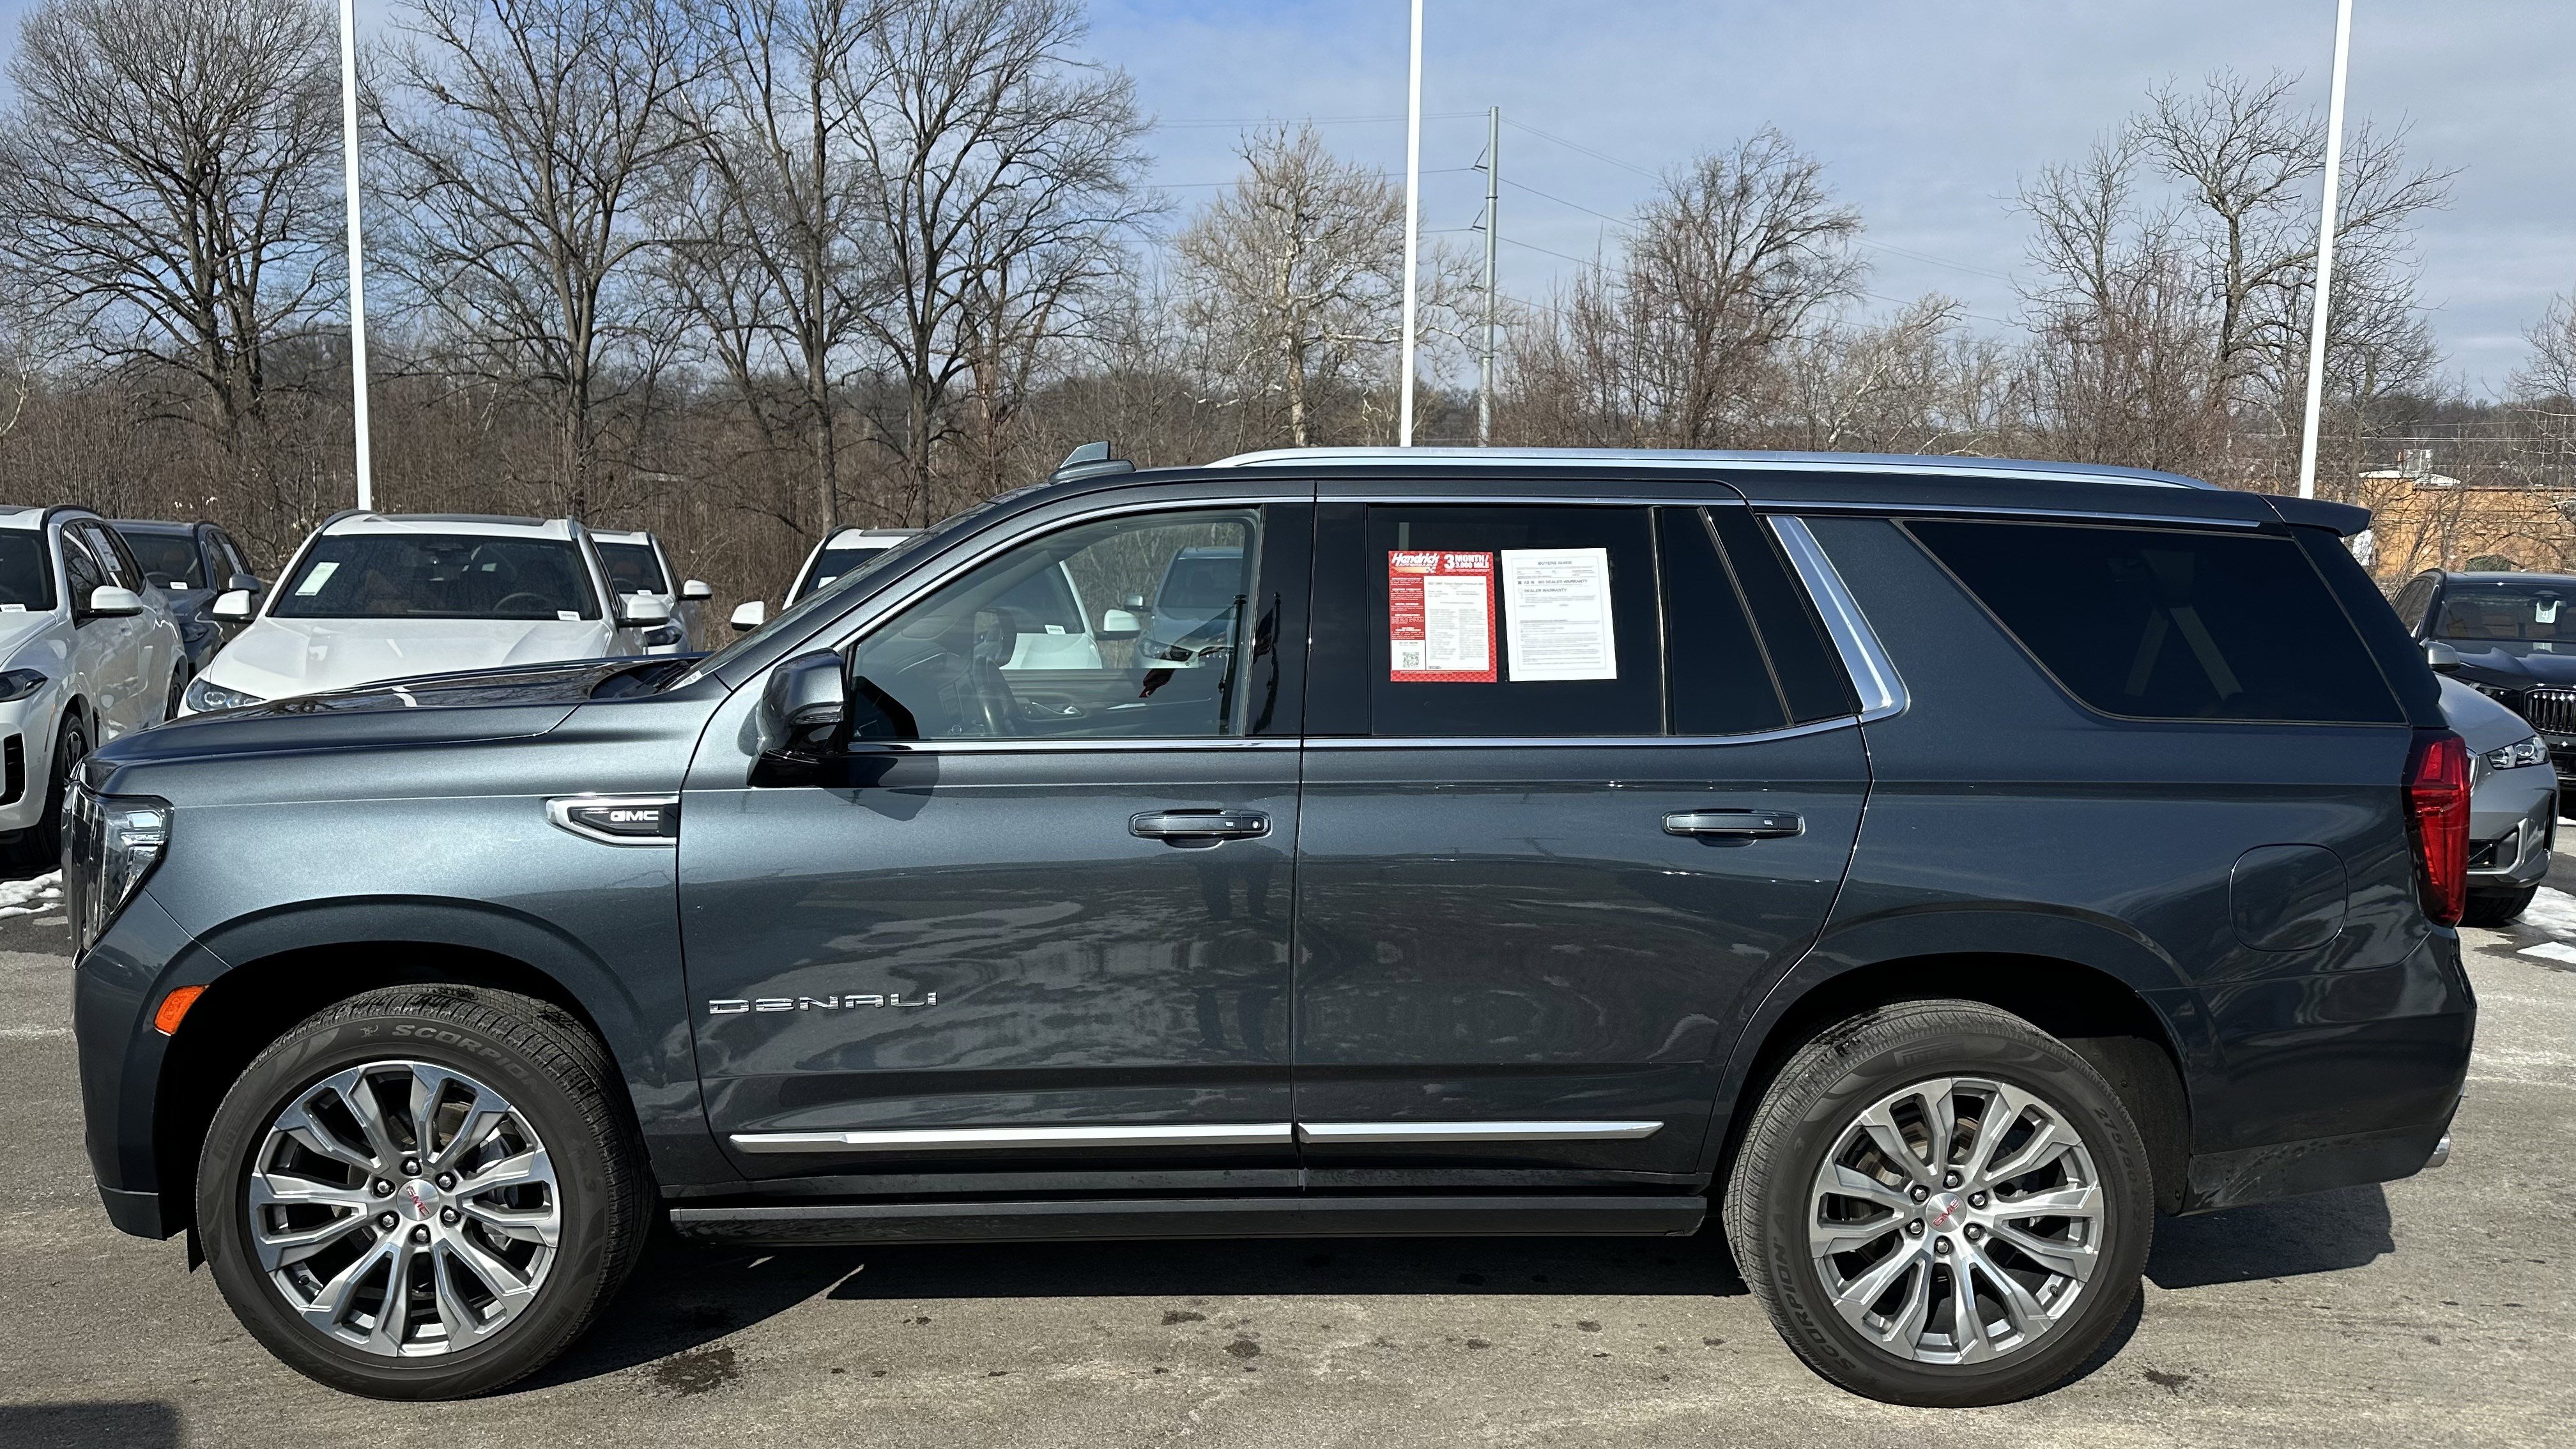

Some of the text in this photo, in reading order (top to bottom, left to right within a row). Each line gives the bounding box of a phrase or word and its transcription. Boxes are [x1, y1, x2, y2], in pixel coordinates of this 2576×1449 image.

[1392, 553, 1440, 567] Hendrick
[1444, 553, 1455, 569] 3
[610, 810, 659, 822] GMC
[709, 992, 937, 1015] DENALI
[391, 1023, 548, 1096] SCORPION
[2093, 1107, 2138, 1184] 275/50
[406, 1185, 430, 1217] GMC
[1933, 1198, 1960, 1227] GMC
[1772, 1239, 1857, 1372] SCORPION
